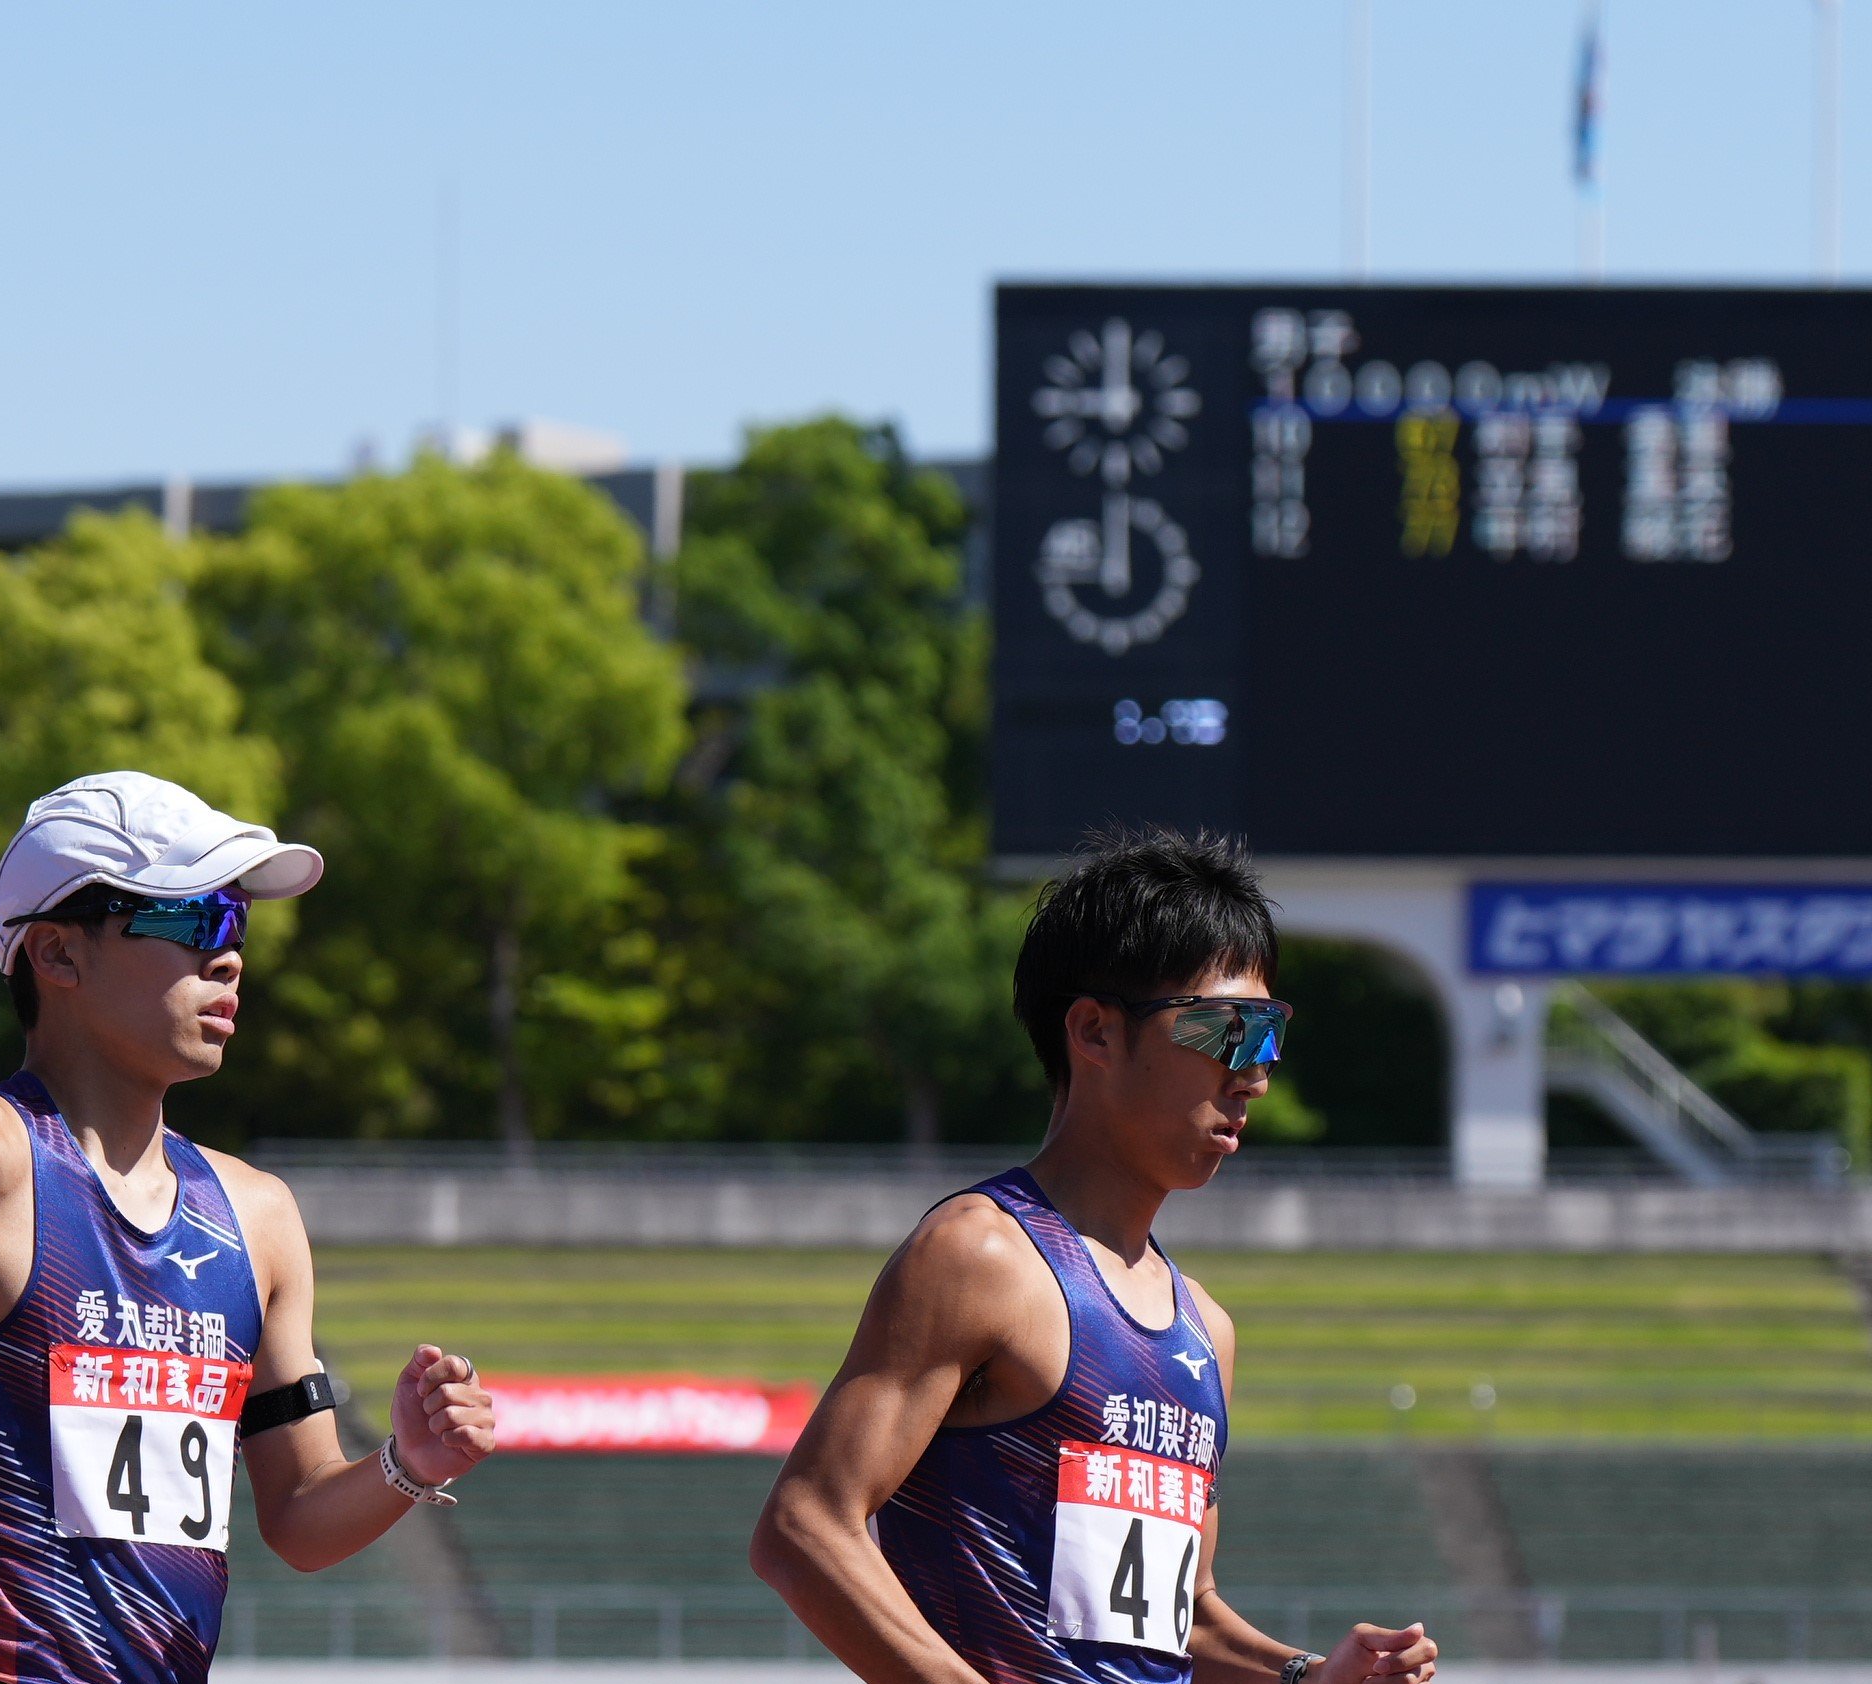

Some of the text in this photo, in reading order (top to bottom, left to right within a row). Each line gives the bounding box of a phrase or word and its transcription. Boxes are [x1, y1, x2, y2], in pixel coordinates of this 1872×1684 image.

[72, 1352, 229, 1415] 新和薬品
[1099, 1393, 1216, 1472] 愛知製鋼
[106, 1415, 213, 1541] 49
[1085, 1450, 1206, 1526] 新和薬品
[1109, 1517, 1195, 1651] 46
